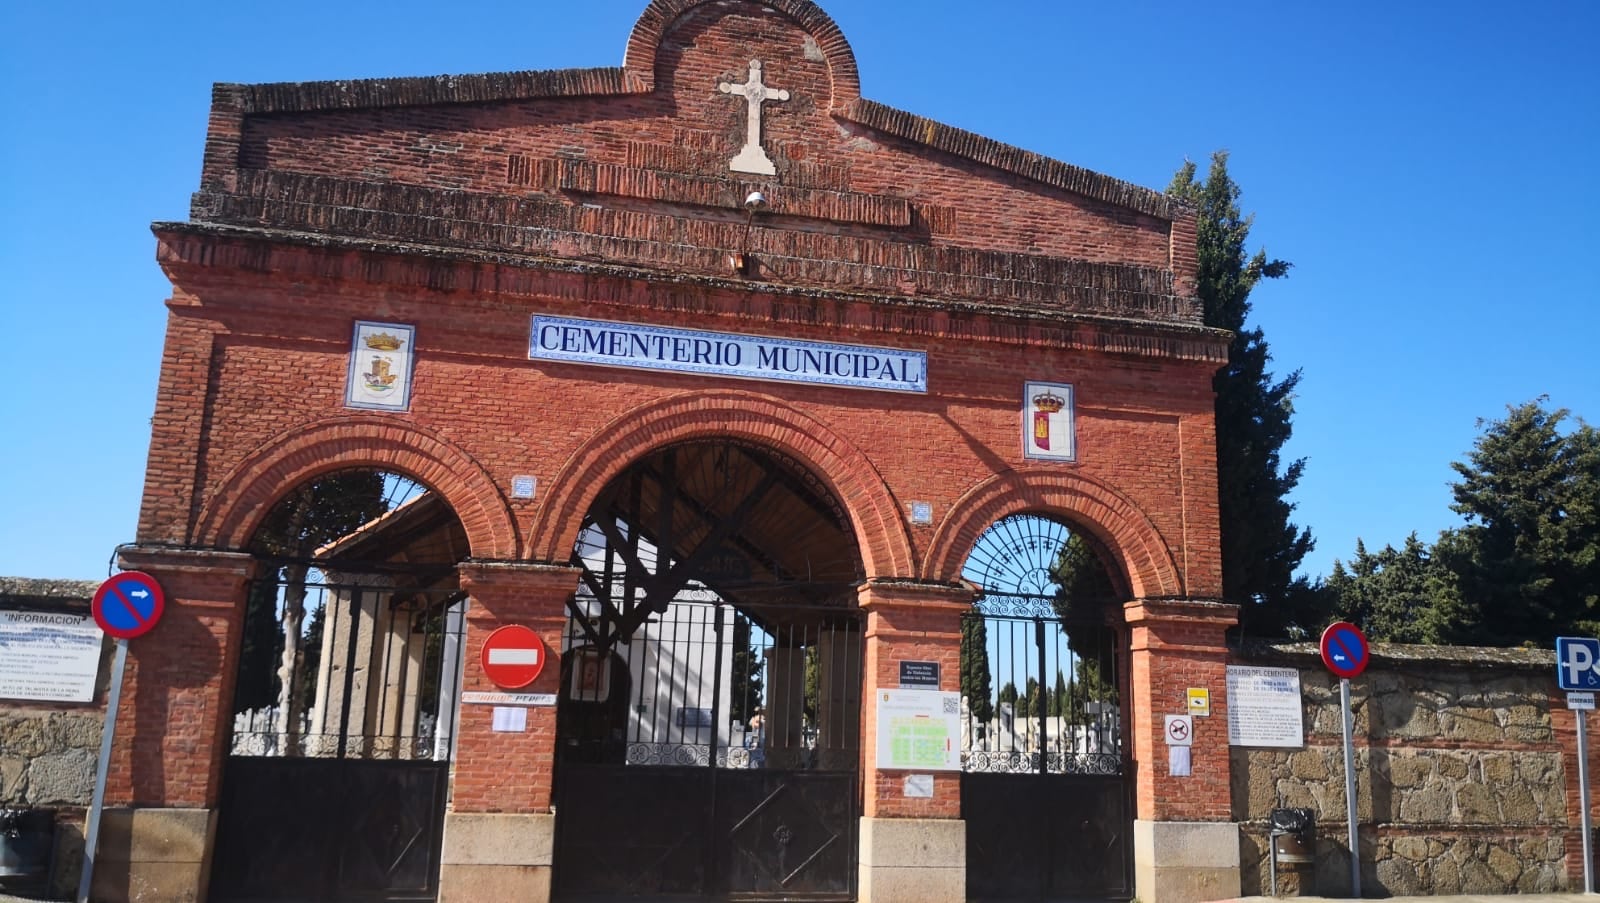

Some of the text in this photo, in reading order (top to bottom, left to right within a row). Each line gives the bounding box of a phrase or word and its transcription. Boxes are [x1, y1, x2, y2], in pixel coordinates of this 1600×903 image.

[540, 325, 919, 383] CEMENTERIO MUNICIPAL
[1263, 670, 1298, 678] CEMENTERIO
[1568, 643, 1593, 685] P
